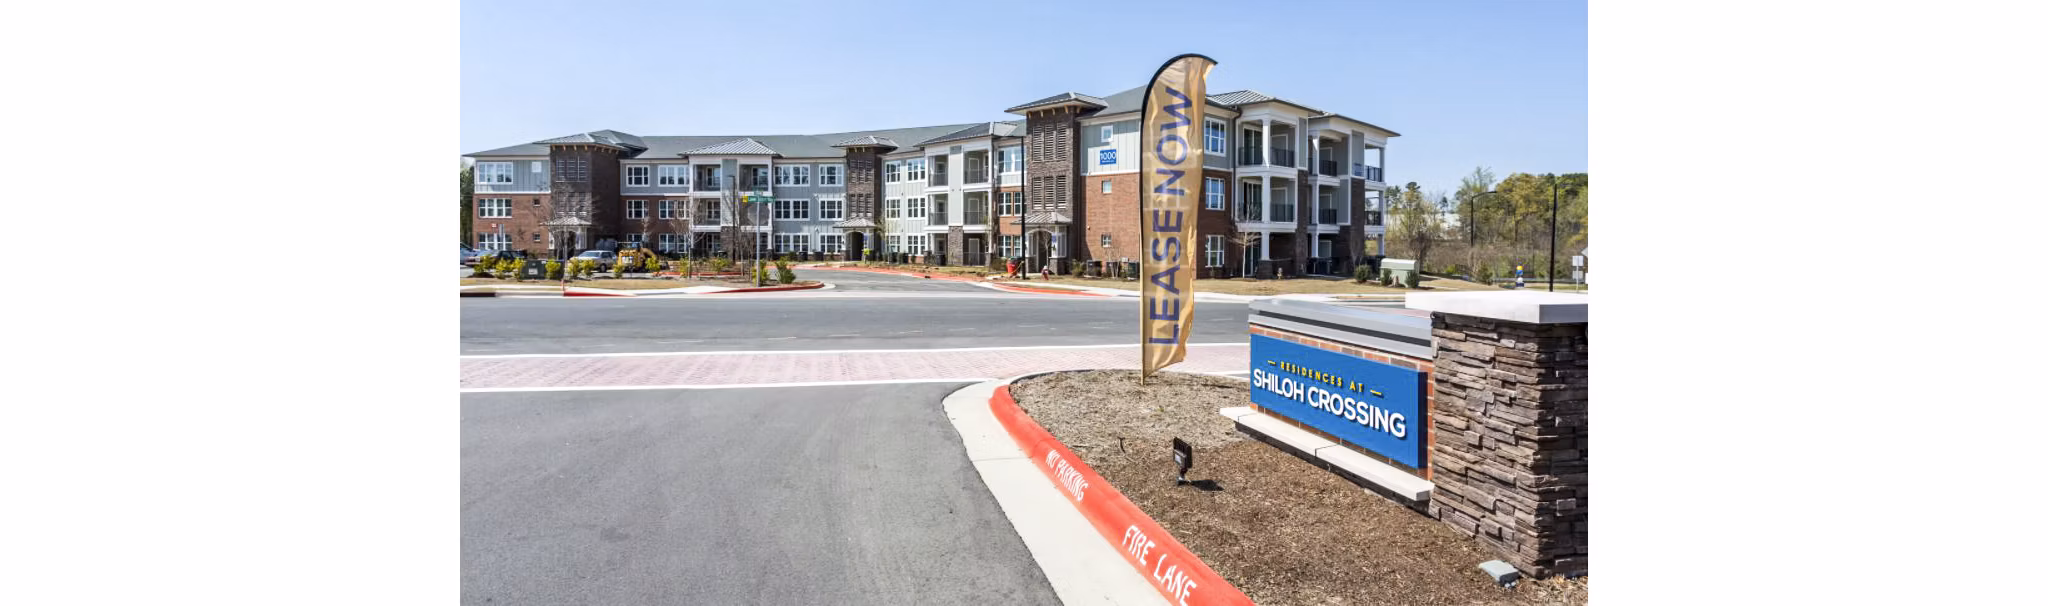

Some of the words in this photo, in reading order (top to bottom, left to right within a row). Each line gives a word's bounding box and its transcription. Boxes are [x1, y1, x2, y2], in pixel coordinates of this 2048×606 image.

[1154, 86, 1193, 197] NOW
[1149, 208, 1183, 345] LEASE
[1253, 368, 1304, 402] SHILOH
[1307, 386, 1406, 438] CROSSING
[1279, 360, 1343, 387] RESIDENCES
[1350, 380, 1364, 393] AT
[1045, 449, 1060, 467] NO
[1055, 458, 1088, 501] PARKING
[1122, 524, 1156, 566] FIRE
[1153, 553, 1197, 606] LANE
